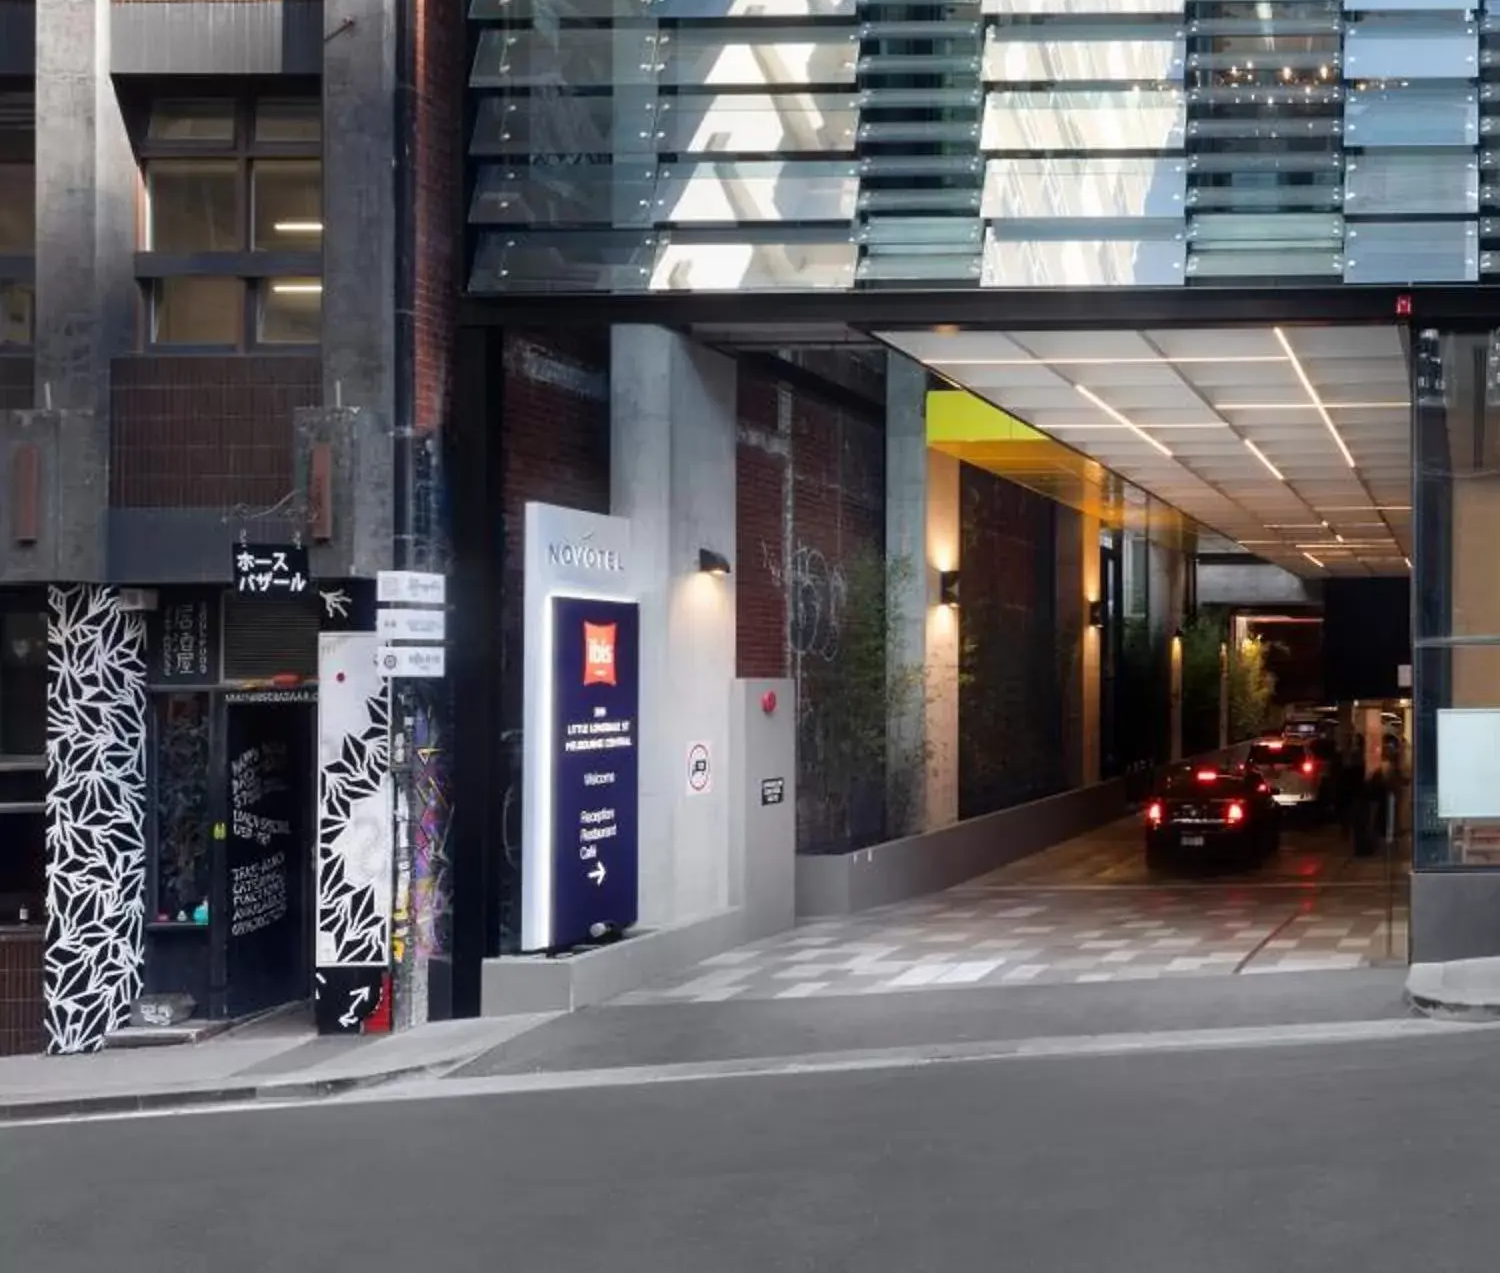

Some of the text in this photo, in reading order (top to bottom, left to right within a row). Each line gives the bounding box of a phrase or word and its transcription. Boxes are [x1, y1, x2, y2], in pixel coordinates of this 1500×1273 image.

[236, 551, 289, 571] ホース
[549, 543, 624, 571] NOVOTEL
[239, 572, 307, 592] バザール
[588, 638, 612, 664] ibis
[580, 808, 615, 824] Reception
[579, 824, 617, 843] Restaurant
